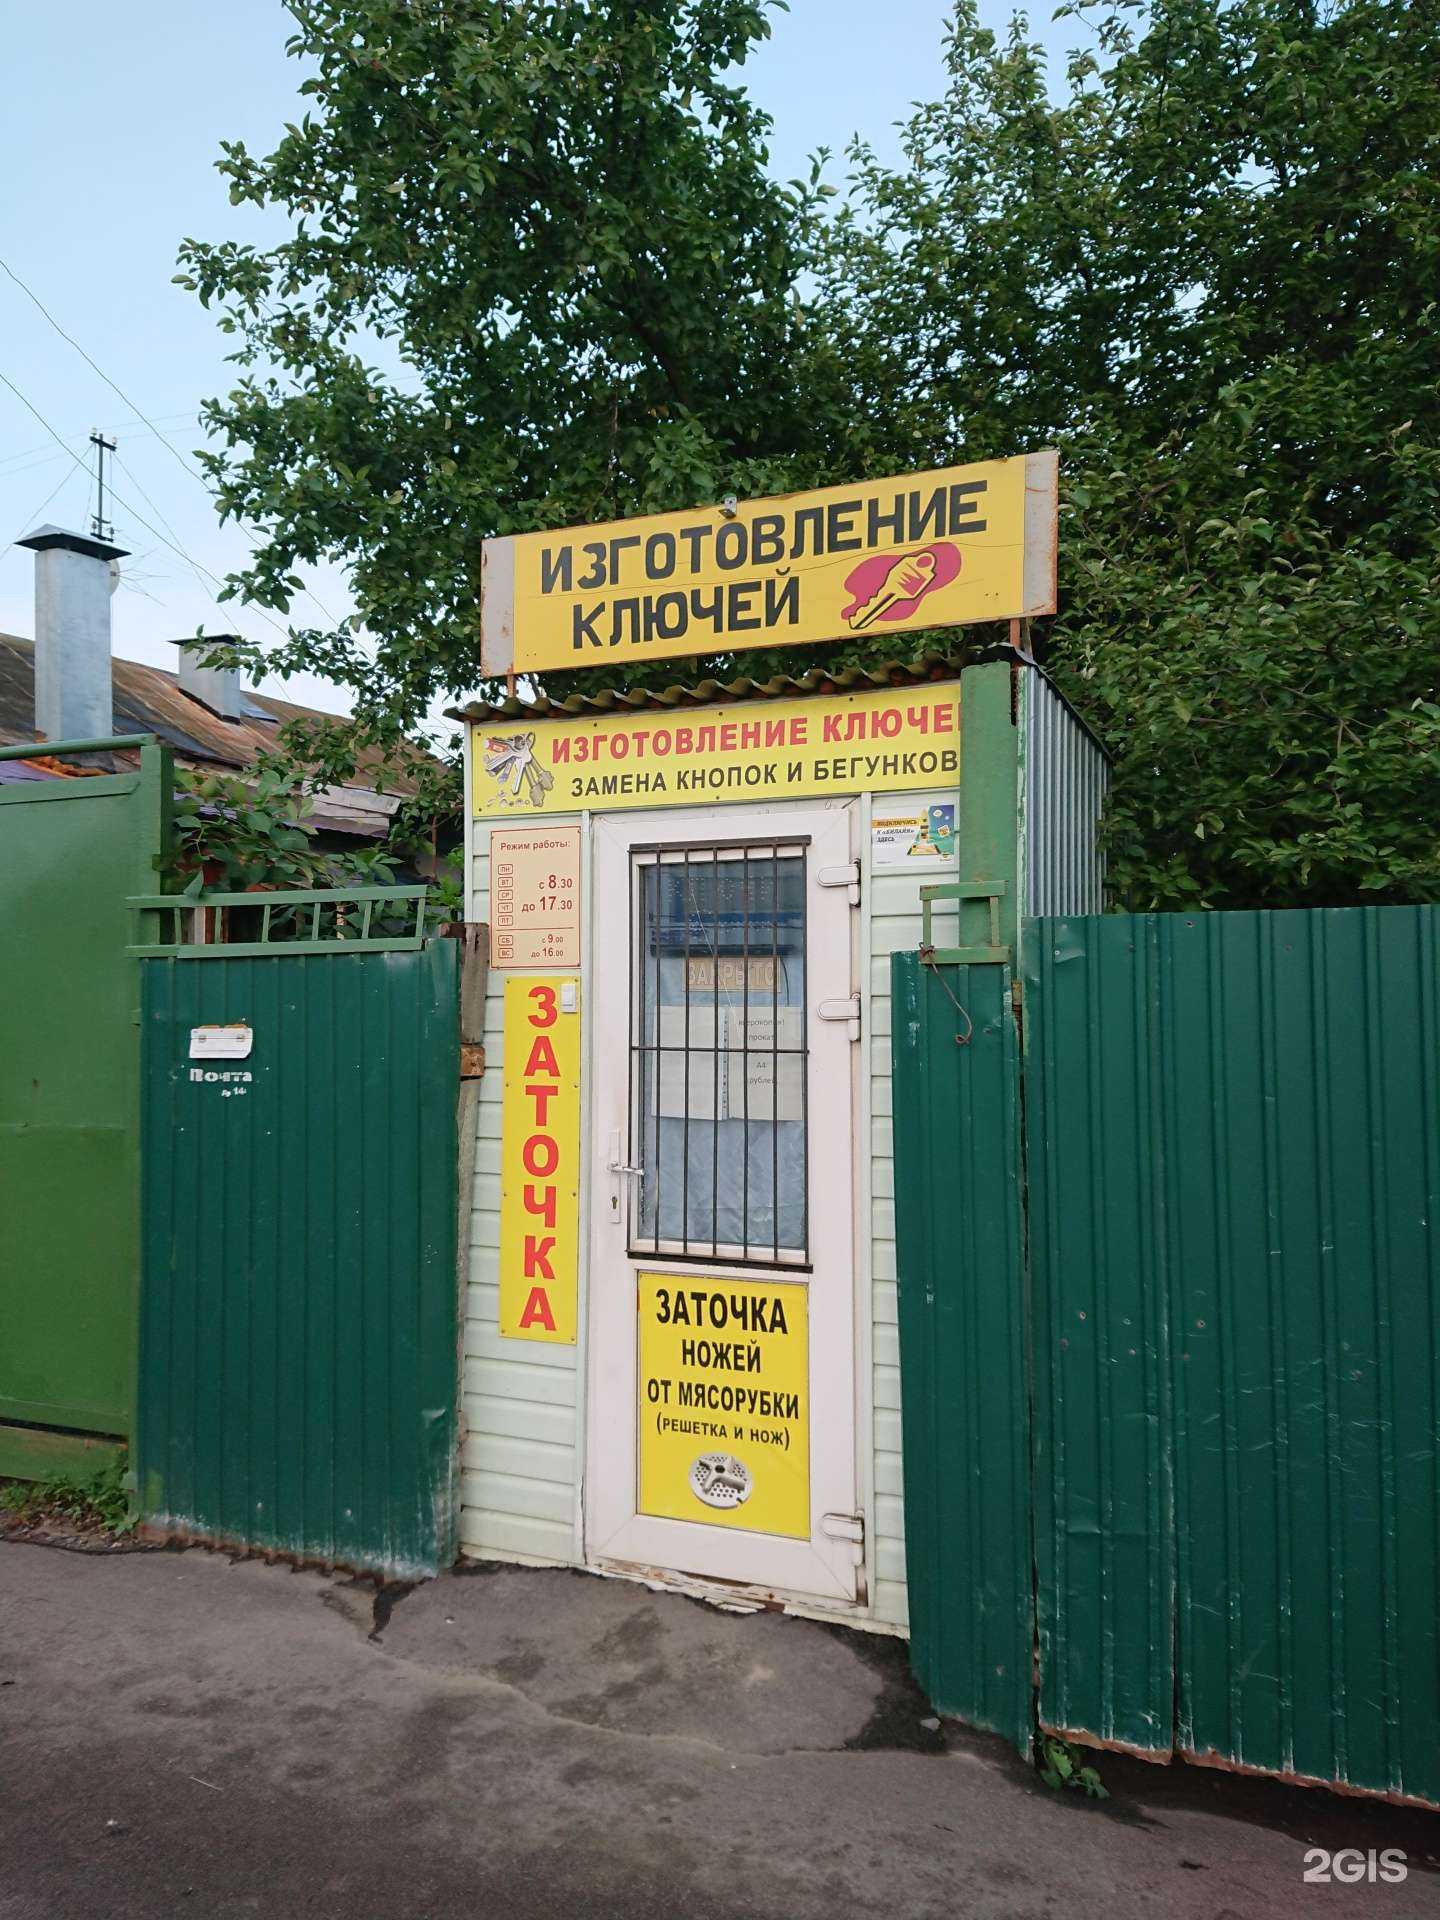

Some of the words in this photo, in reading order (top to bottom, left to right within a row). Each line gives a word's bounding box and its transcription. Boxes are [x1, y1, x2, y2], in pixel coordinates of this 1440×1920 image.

[541, 480, 988, 595] ИЗГОТОВЛЕНИЕ
[572, 566, 801, 651] КЛЮЧЕЙ
[552, 717, 809, 764] ИЗГОТОВЛЕНИЕ
[823, 702, 961, 743] КЛЮЧЕ
[571, 772, 667, 797] ЗАМЕНА
[677, 761, 779, 790] КНОПОК
[787, 761, 803, 783] И
[814, 750, 958, 781] БЕГУНКОВ
[500, 842, 530, 851] Режим
[533, 839, 570, 851] работы:
[539, 881, 545, 890] с
[548, 874, 573, 890] 8.30
[521, 903, 536, 913] до
[539, 895, 573, 911] 17.30
[542, 947, 564, 958] 16.00
[547, 934, 564, 944] 9.00
[189, 1068, 253, 1082] Почта
[519, 985, 561, 1332] ЗАТОЧКА
[656, 1288, 788, 1335] ЗАТОЧКА
[682, 1338, 761, 1373] НОЖЕЙ
[647, 1378, 672, 1404] ОТ
[678, 1381, 799, 1420] МЯСОРУБКИ
[656, 1411, 728, 1438] (РЕШЕТКА
[734, 1426, 743, 1440] И
[750, 1427, 790, 1451] НОЖ)
